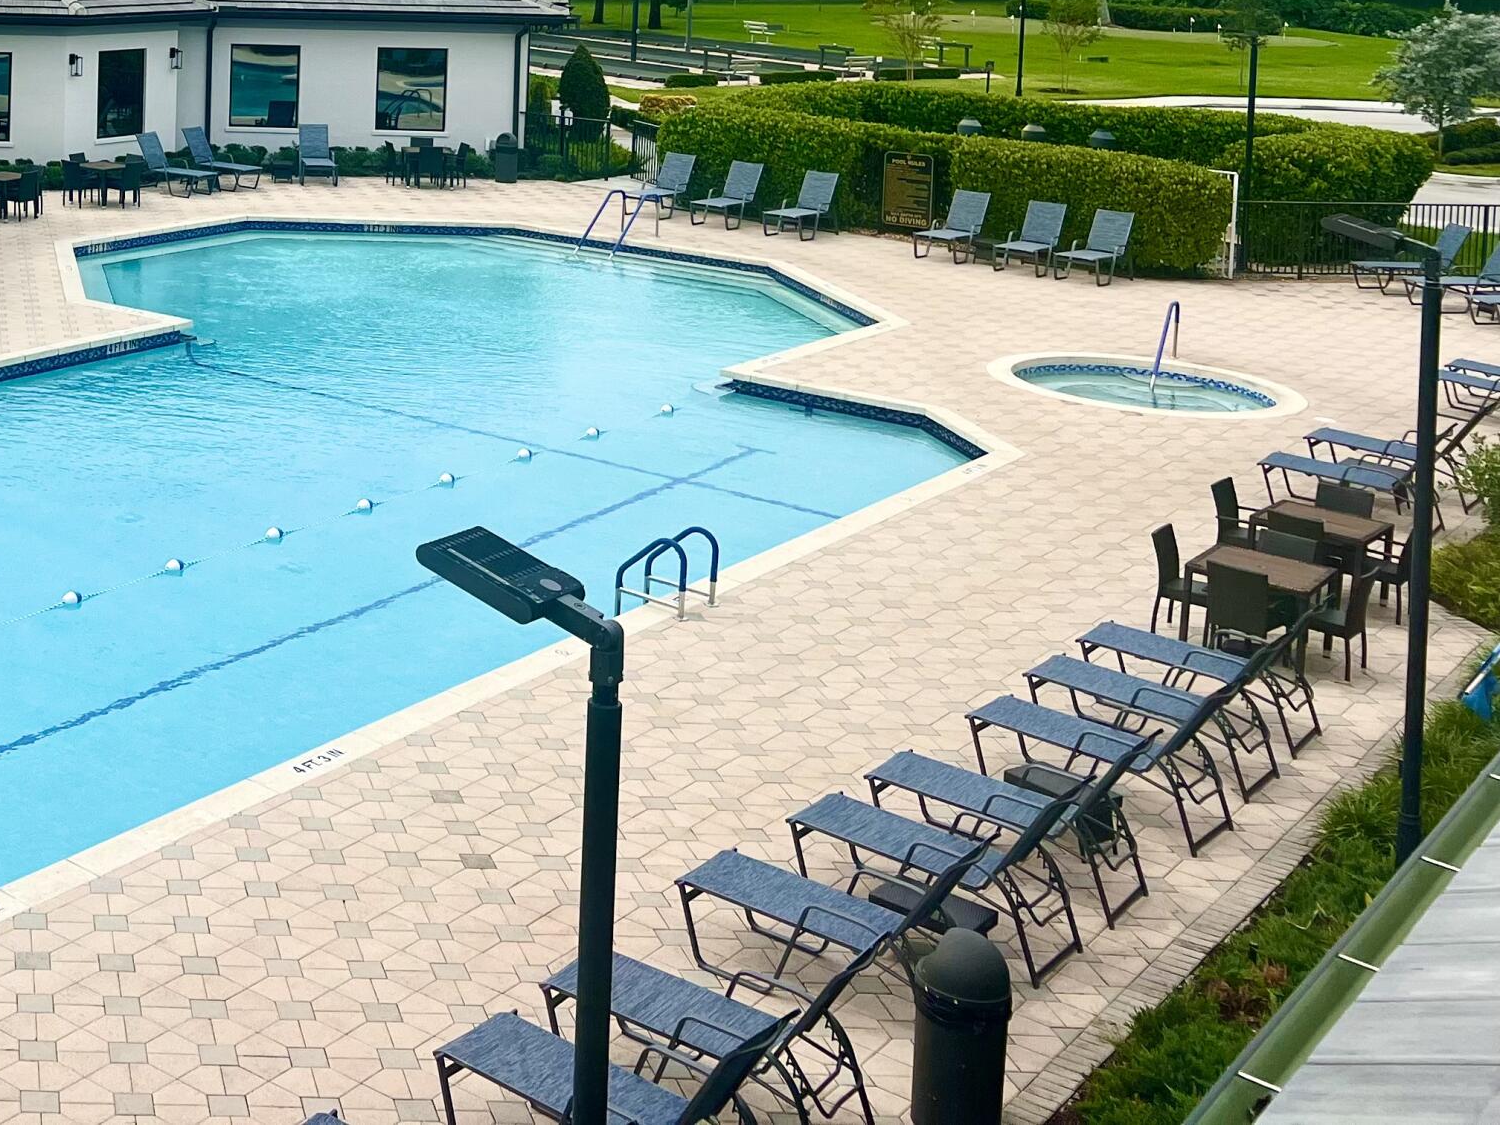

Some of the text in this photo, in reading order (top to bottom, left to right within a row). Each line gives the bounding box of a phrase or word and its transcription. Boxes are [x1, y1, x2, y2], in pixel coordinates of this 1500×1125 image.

[907, 159, 926, 168] RULES
[885, 214, 927, 227] NO DIVING
[129, 339, 137, 349] IN
[317, 755, 332, 763] 3
